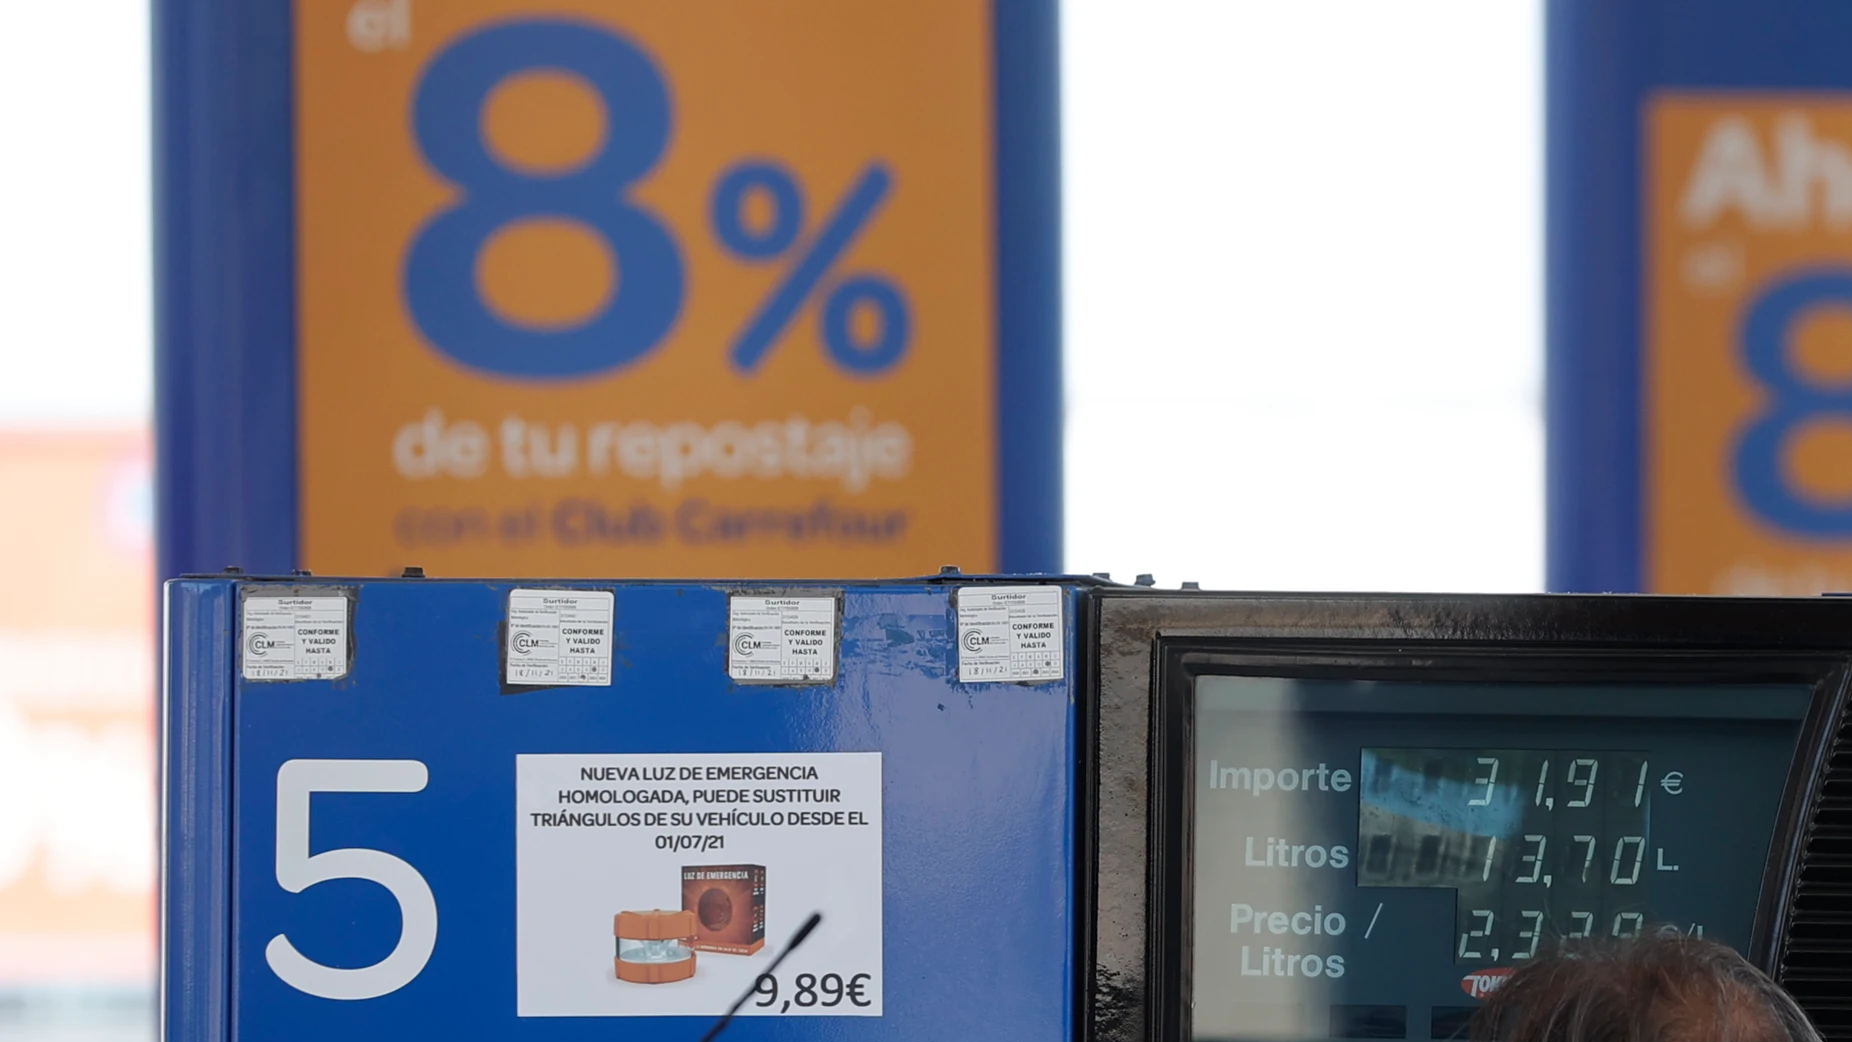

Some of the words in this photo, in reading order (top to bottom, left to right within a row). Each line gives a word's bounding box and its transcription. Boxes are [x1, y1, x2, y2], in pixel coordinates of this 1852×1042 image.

[393, 407, 490, 479] de
[500, 412, 576, 478] tu
[588, 406, 912, 492] repostaje
[562, 628, 604, 636] CONFORME
[1012, 622, 1055, 630] CONFORME
[1020, 641, 1047, 649] HASTA
[580, 767, 640, 781] NUEVA
[642, 767, 677, 781] LUZ
[679, 767, 703, 780] DE
[706, 766, 818, 780] EMERGENCIA
[1208, 759, 1353, 797] Importe
[1467, 757, 1648, 810] 31,91
[1660, 771, 1684, 795] €
[558, 790, 690, 806] HOMOLOGADA,
[693, 789, 750, 804] PUEDE
[752, 788, 841, 803] SUSTITUIR
[530, 809, 641, 827] TRIÁNGULOS
[644, 812, 669, 826] DE
[672, 812, 697, 826] SU
[699, 808, 785, 826] VEHÍCULO
[787, 811, 846, 826] DESDE
[848, 811, 869, 825] EL
[655, 835, 725, 852] 01/07/21
[1244, 835, 1349, 869] Litros
[1482, 834, 1646, 887] 13,70
[264, 758, 441, 1002] 5
[1230, 903, 1346, 936] Precio
[1240, 946, 1345, 979] Litros
[754, 972, 872, 1014] 9,89€
